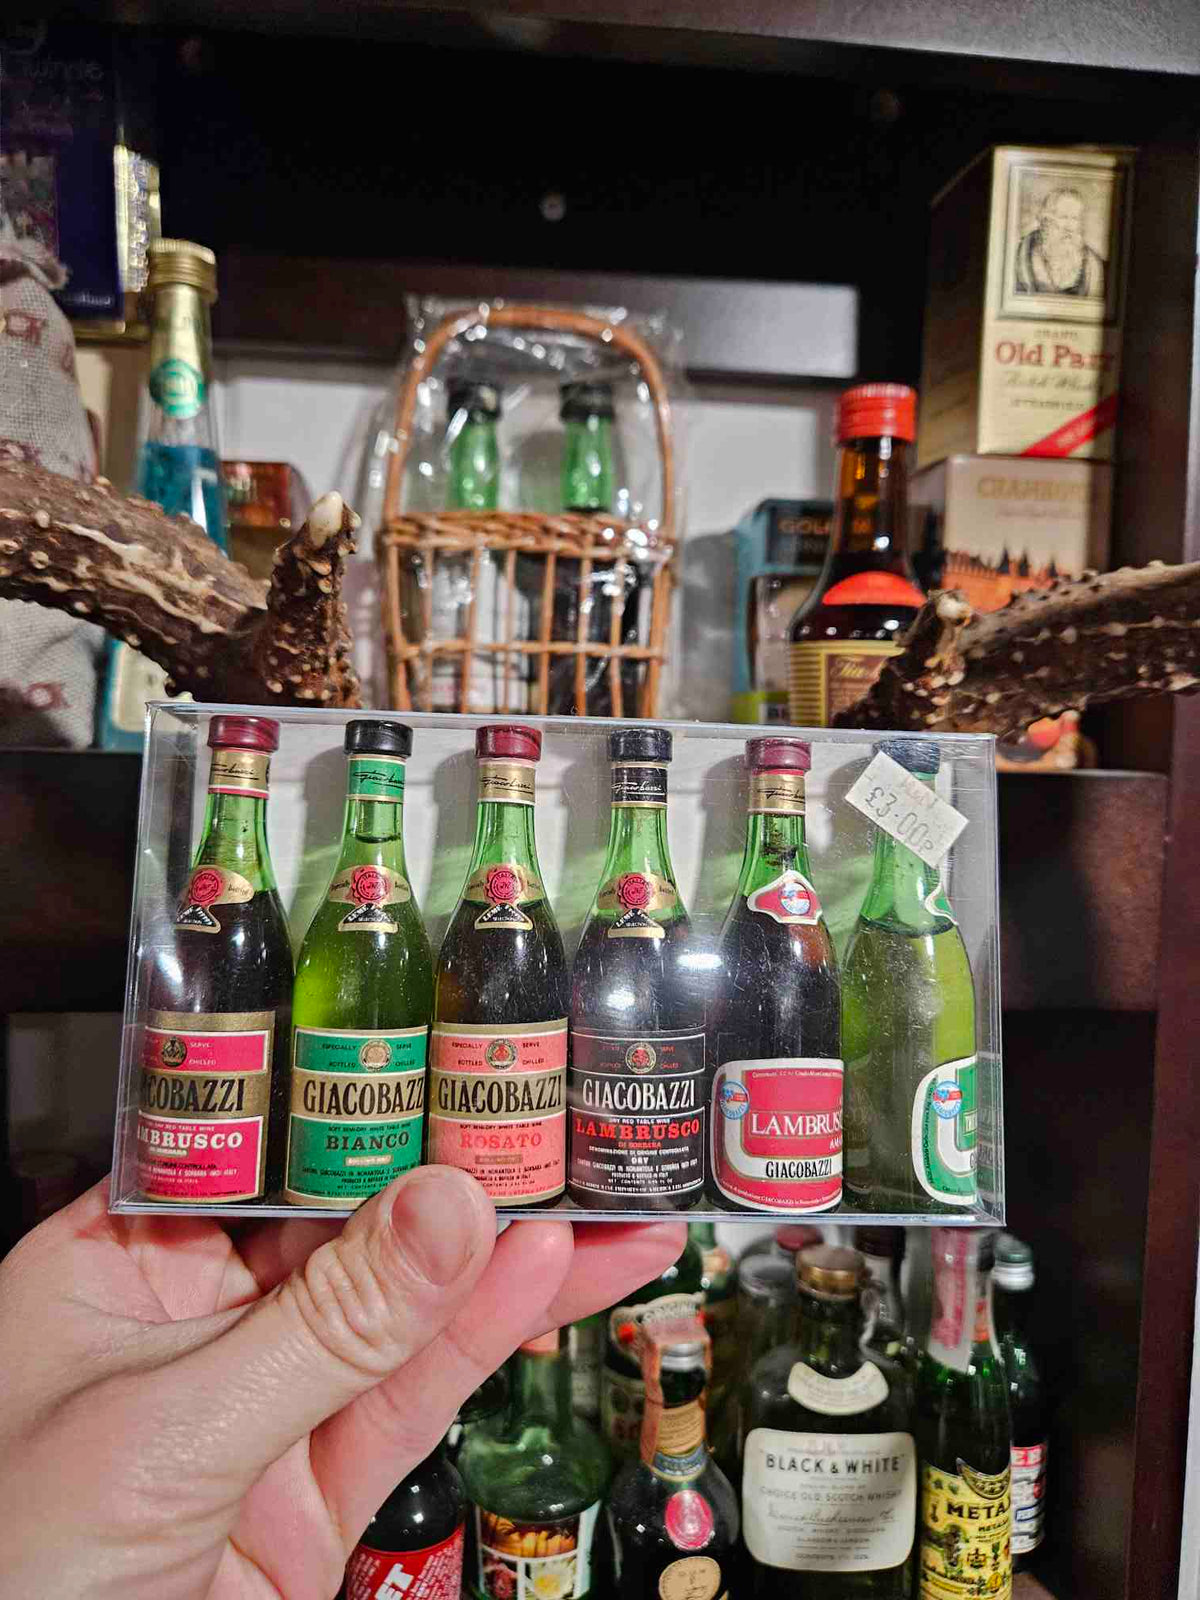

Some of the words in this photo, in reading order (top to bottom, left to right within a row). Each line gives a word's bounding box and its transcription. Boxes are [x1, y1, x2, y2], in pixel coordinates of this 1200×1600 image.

[995, 341, 1043, 367] Old
[438, 1075, 562, 1114] GIACOBAZZI
[582, 1079, 695, 1111] GIACOBAZZI
[138, 1126, 243, 1149] MBRUSCO
[575, 1117, 700, 1140] LAMBRUSCO
[325, 1131, 411, 1152] BIANCO
[460, 1133, 543, 1150] ROSATO
[765, 1158, 832, 1179] GIACOBAZZI
[766, 1454, 824, 1473] BLACK
[831, 1463, 839, 1474] &
[846, 1456, 900, 1474] WHITE
